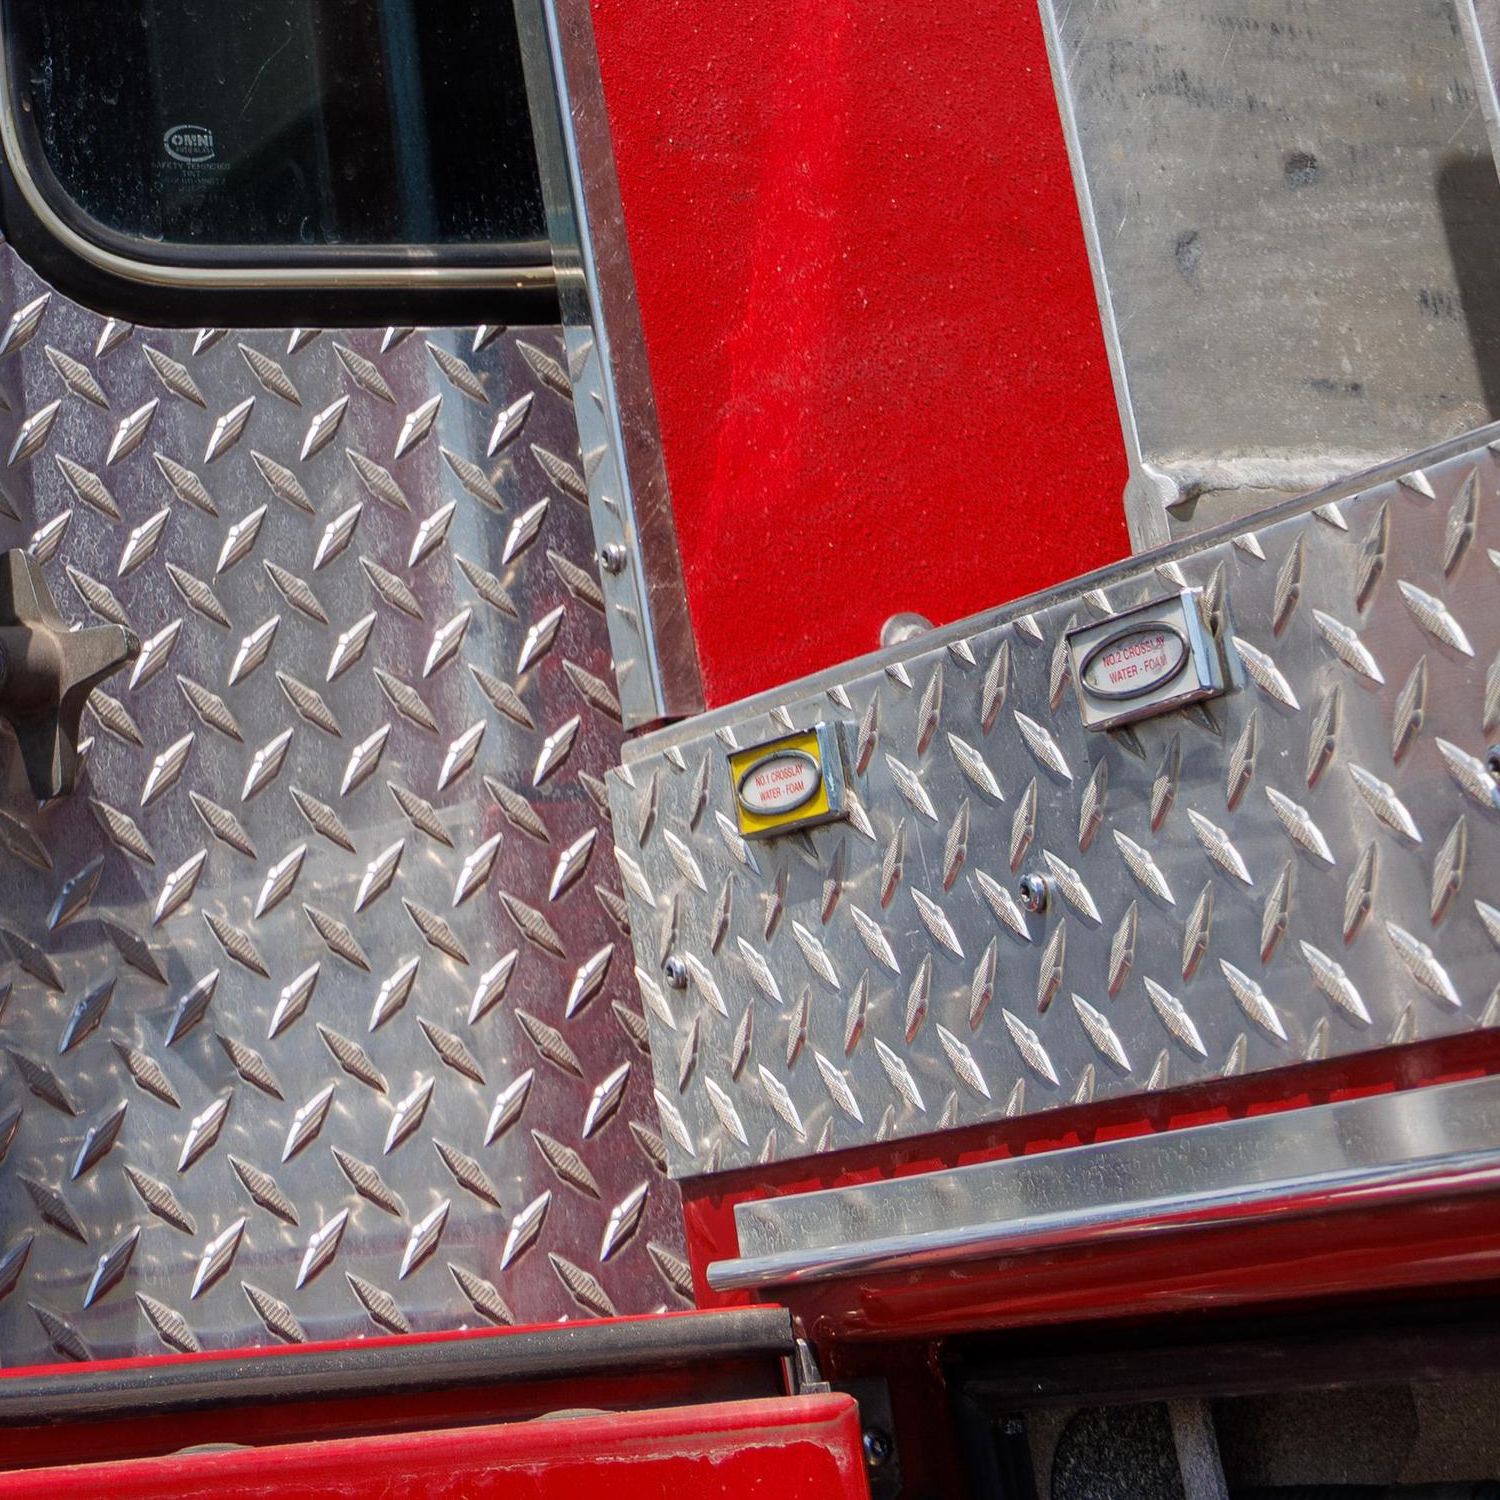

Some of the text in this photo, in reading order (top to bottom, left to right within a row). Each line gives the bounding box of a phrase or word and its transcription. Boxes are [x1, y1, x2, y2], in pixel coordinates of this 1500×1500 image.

[1102, 635, 1165, 667] NO.2 CROSSLAY
[1109, 664, 1139, 683] WATER
[1144, 654, 1168, 673] FOAM
[771, 761, 804, 783] CROSSLAY
[759, 787, 782, 802] WATER
[786, 780, 805, 795] FOAM
